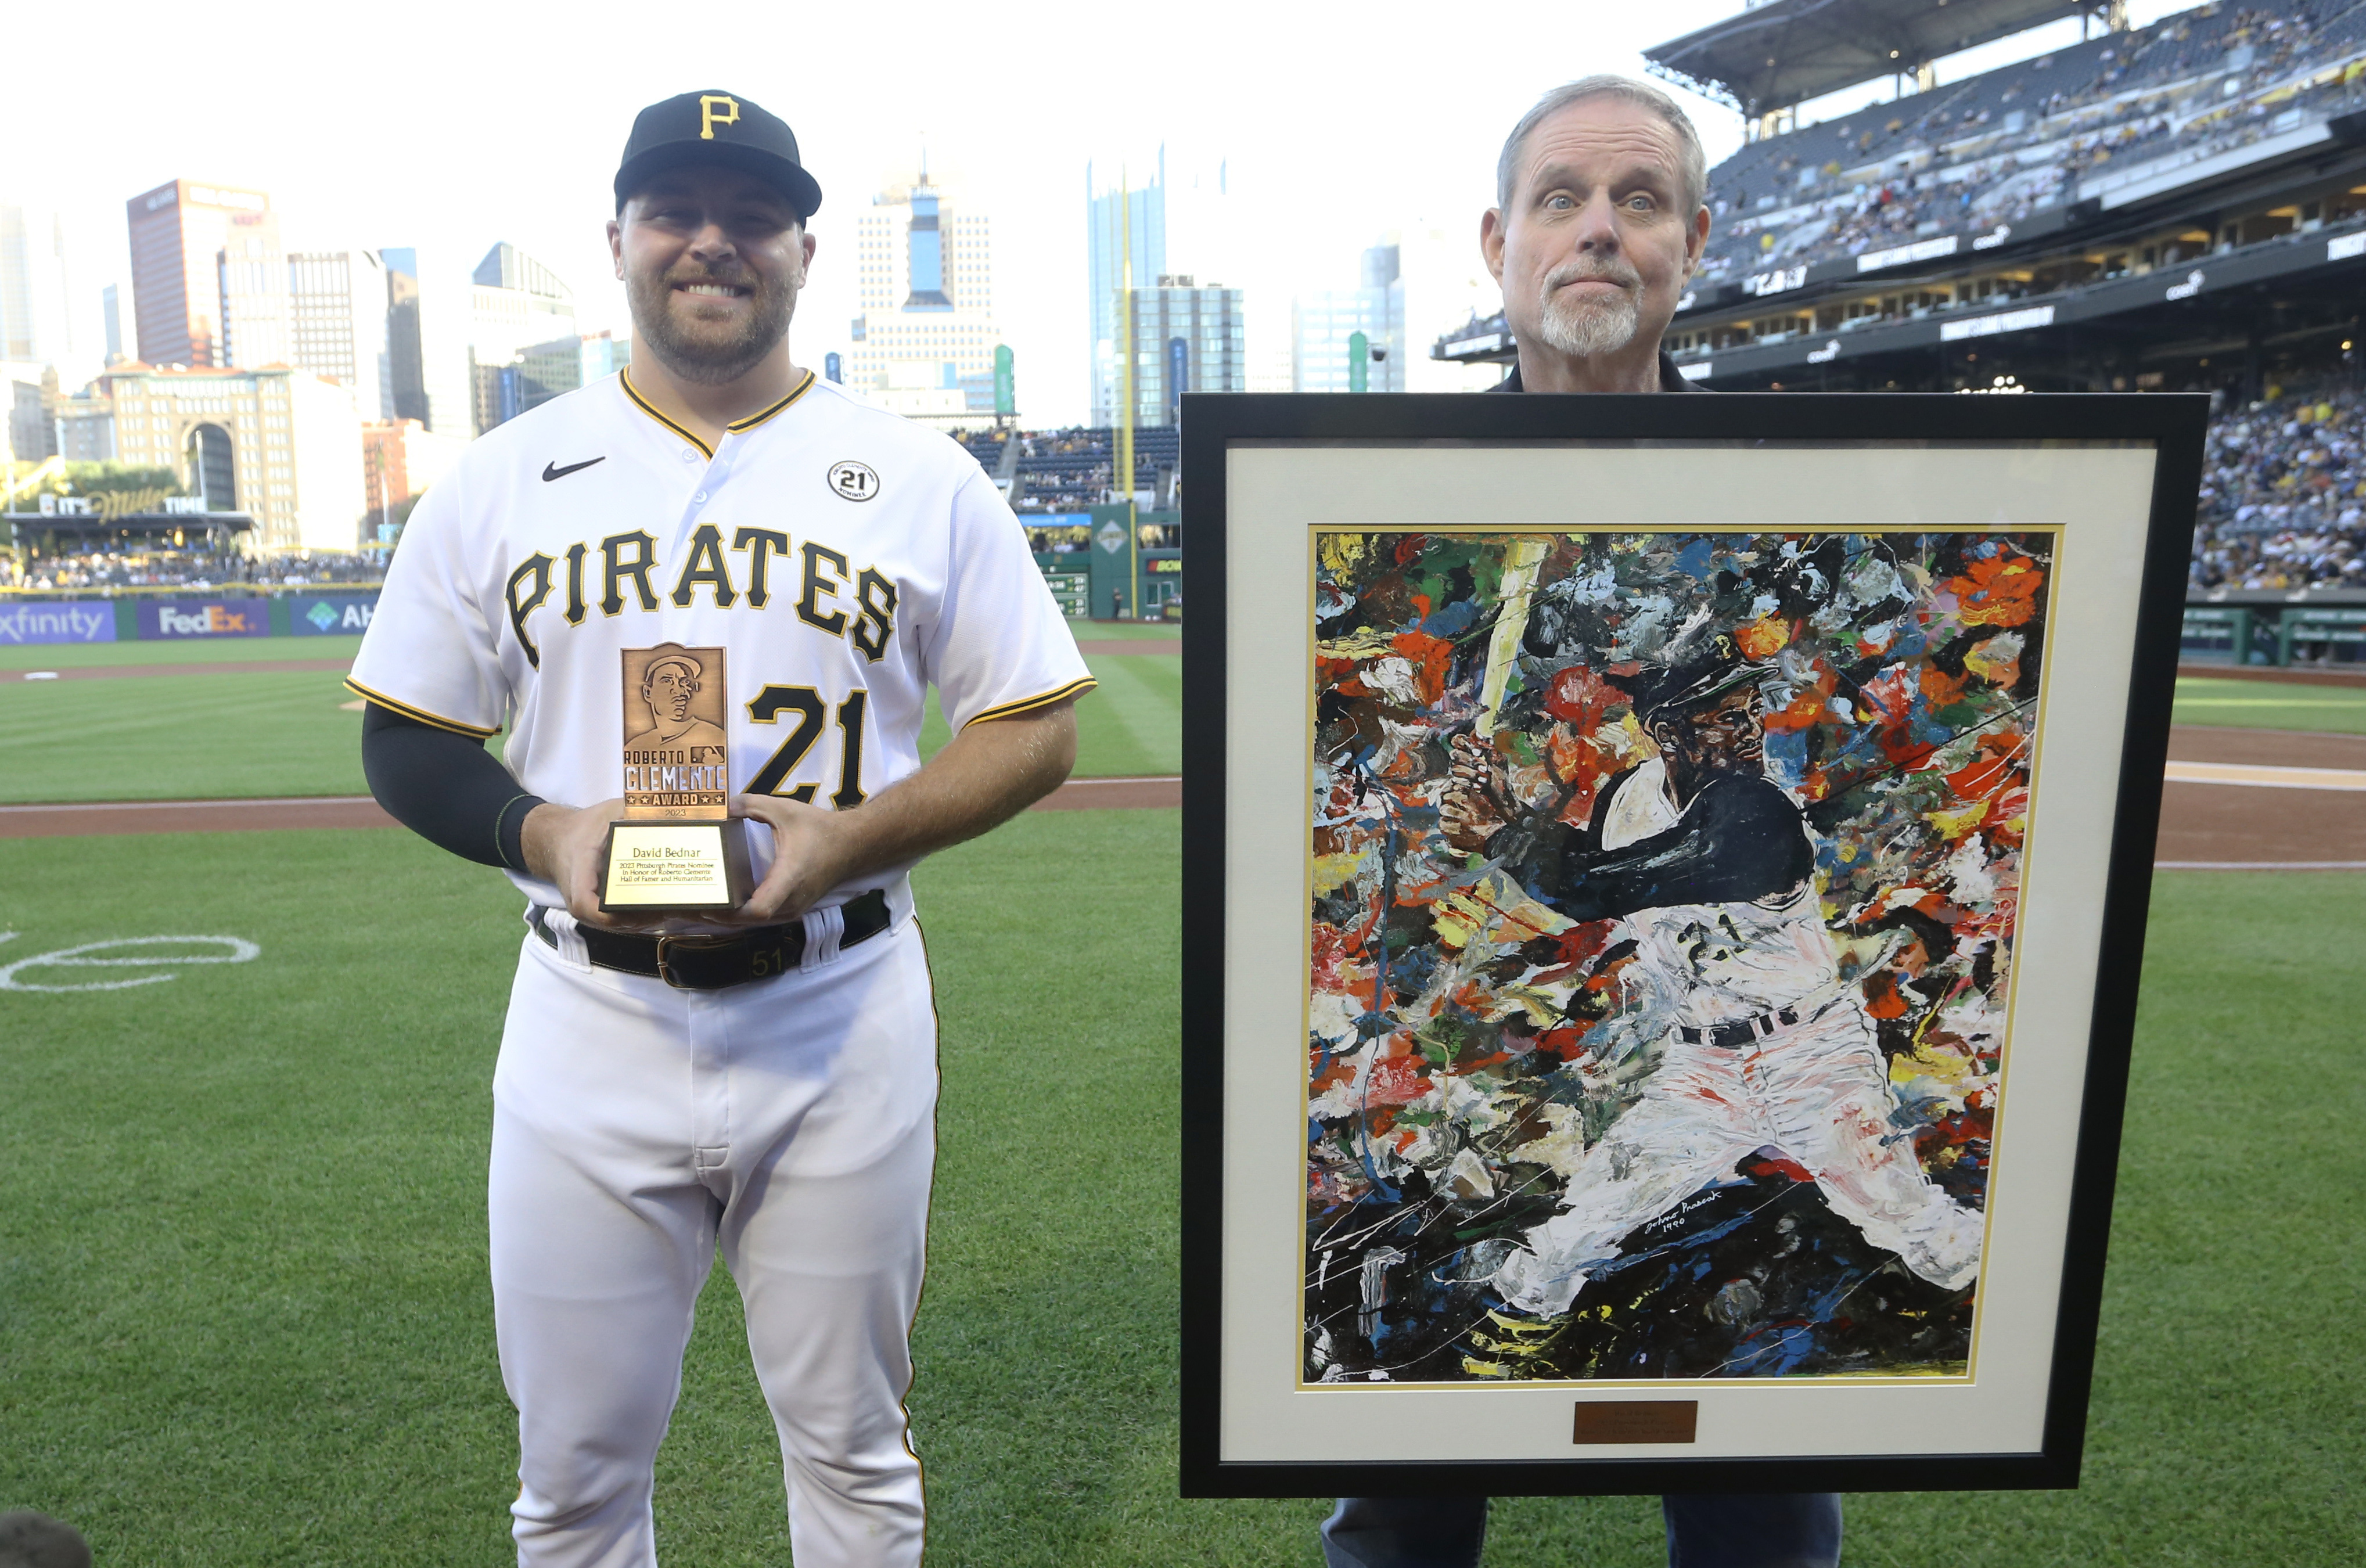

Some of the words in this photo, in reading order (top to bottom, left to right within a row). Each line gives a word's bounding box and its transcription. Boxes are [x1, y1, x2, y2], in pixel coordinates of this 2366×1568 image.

[699, 95, 740, 140] P
[840, 469, 865, 490] 21
[838, 487, 867, 497] NOMINEE
[164, 495, 207, 515] TIME
[505, 523, 899, 672] PIRATES
[159, 605, 246, 634] FedEx
[624, 751, 684, 764] ROBERTO
[740, 684, 869, 811] 21
[626, 766, 725, 791] CLEMENTE
[653, 793, 698, 805] AWARD
[633, 848, 661, 858] David
[665, 847, 701, 857] Bednar
[753, 947, 781, 976] 51
[1663, 1217, 1685, 1233] 1990
